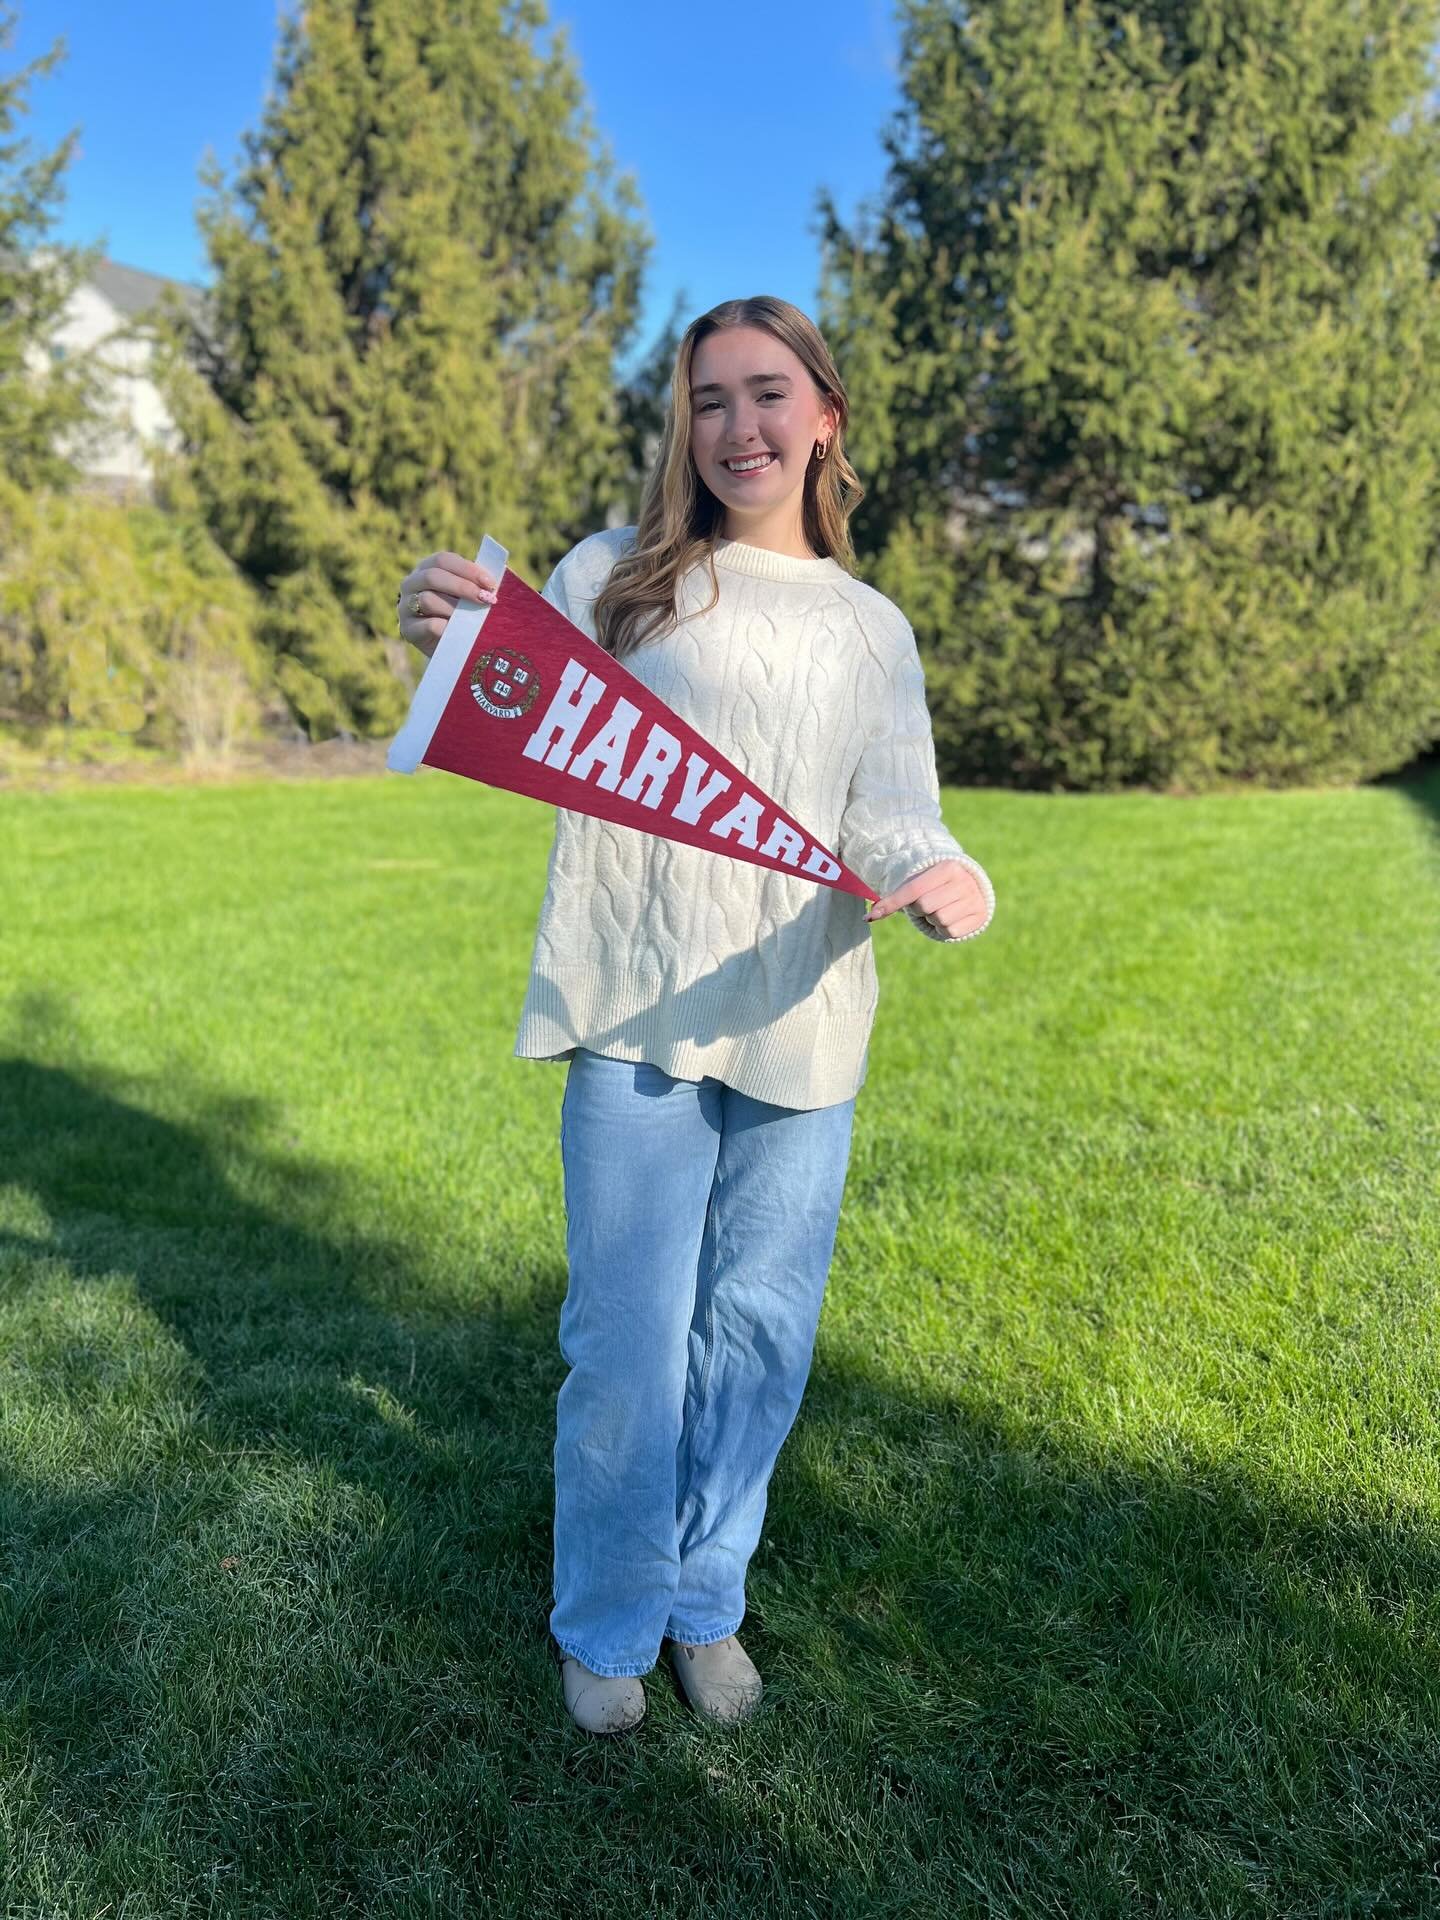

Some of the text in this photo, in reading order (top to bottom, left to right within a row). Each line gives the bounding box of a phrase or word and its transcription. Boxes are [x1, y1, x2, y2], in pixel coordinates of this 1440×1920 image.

[496, 660, 507, 670] VE
[496, 683, 509, 694] TAS
[476, 694, 512, 718] HARVARD
[522, 658, 842, 882] HARVARD
